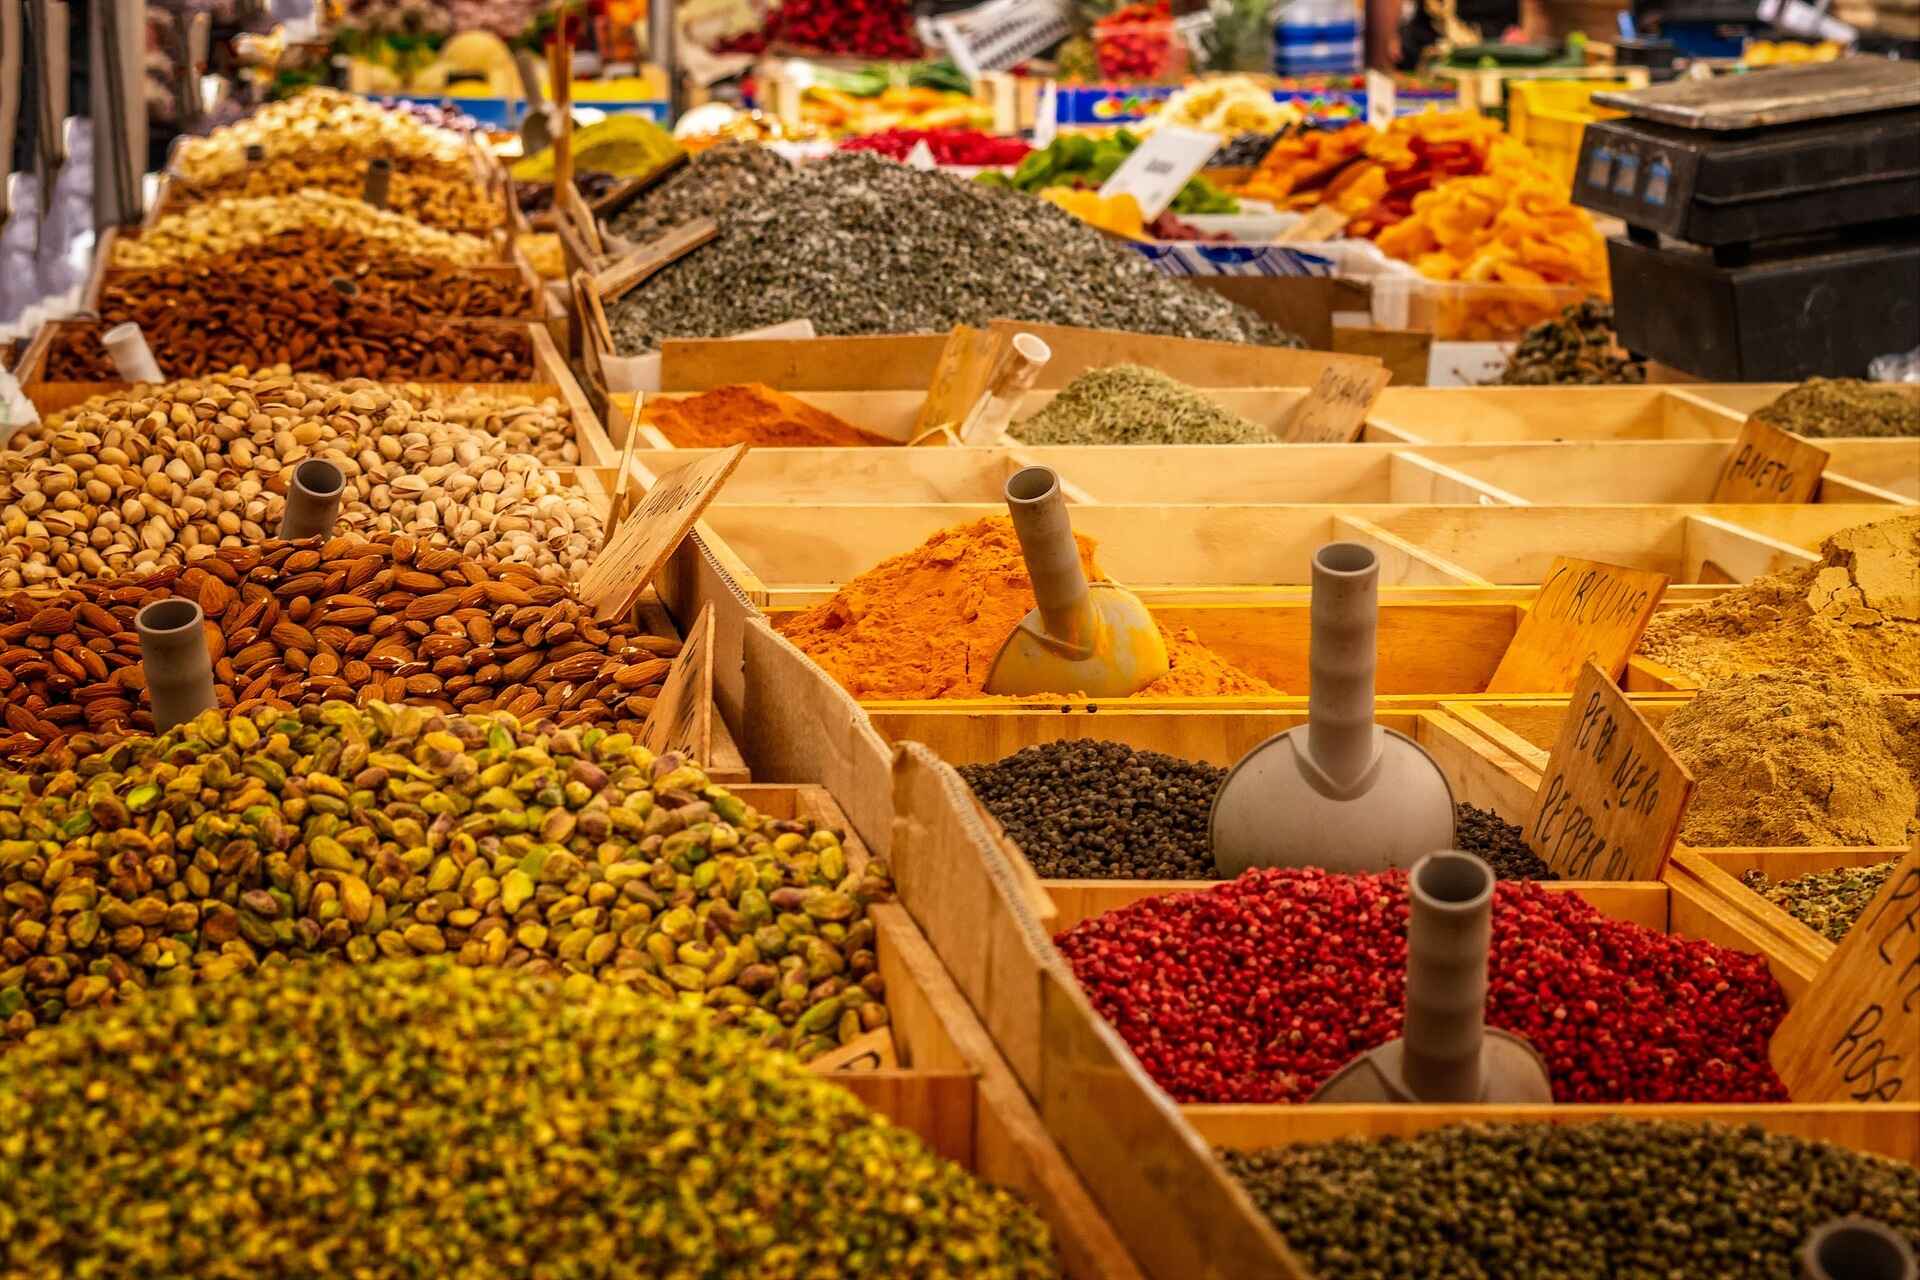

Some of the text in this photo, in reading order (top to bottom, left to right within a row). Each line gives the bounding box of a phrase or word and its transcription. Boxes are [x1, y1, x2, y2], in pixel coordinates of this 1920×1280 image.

[1727, 443, 1795, 493] ANETO
[1532, 566, 1648, 628] CURCUMA
[1611, 745, 1660, 817] NERO
[1533, 773, 1607, 880] PEPPER
